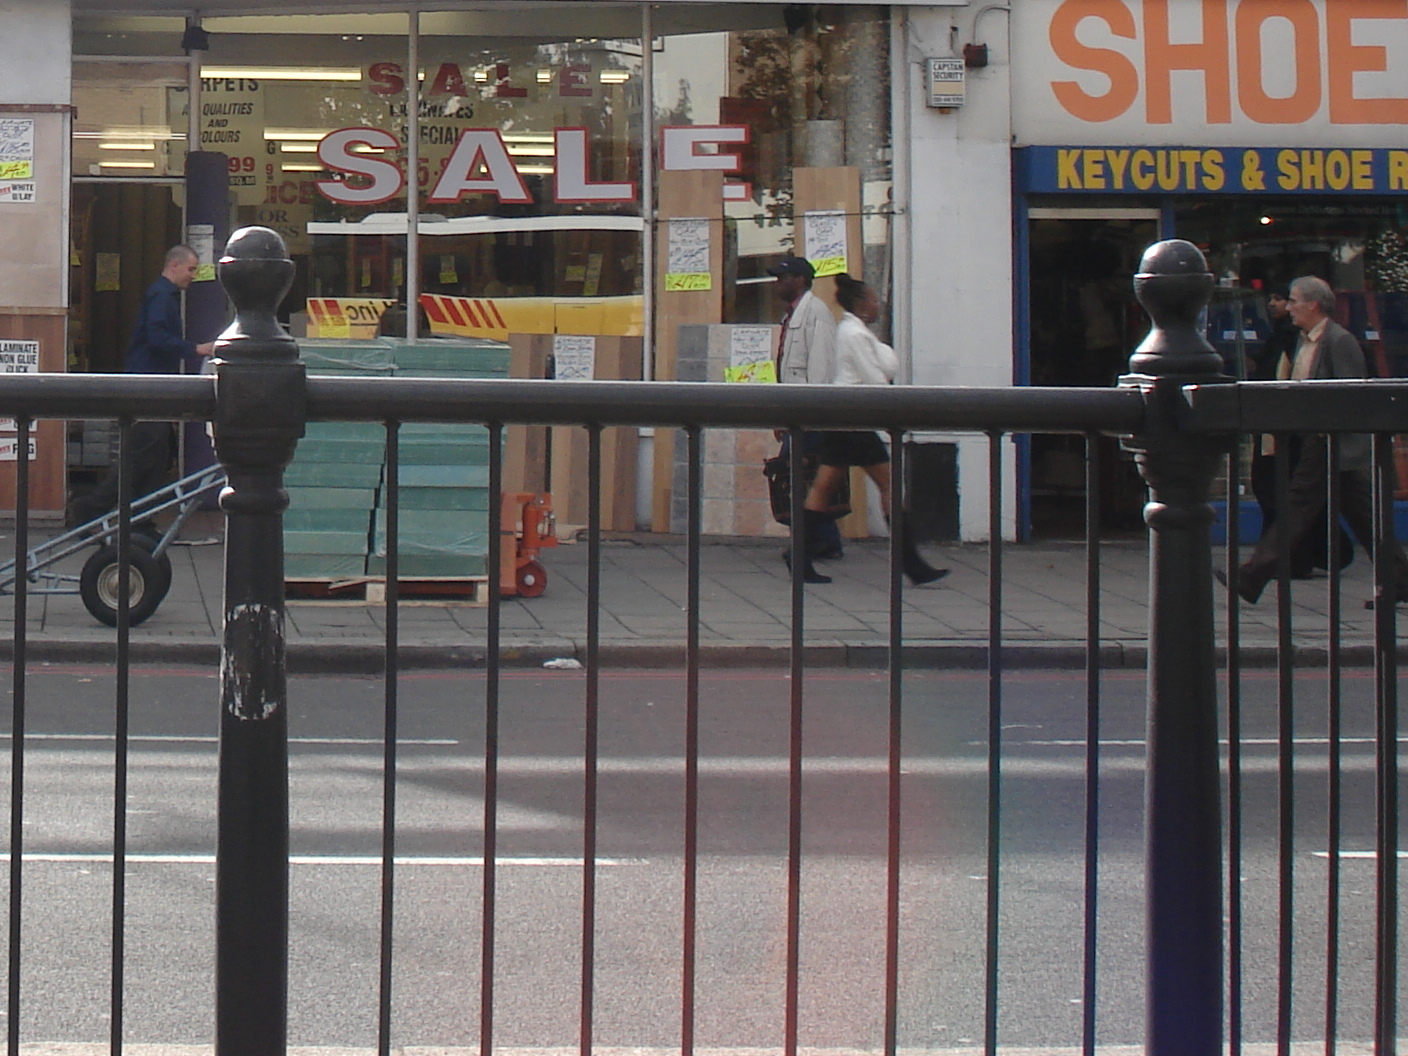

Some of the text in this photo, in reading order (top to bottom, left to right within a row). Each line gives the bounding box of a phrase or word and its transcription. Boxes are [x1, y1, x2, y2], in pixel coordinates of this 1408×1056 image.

[933, 63, 963, 71] CAPSTAN
[369, 62, 593, 98] SALE
[933, 72, 963, 80] SECURITY
[203, 103, 254, 116] QUALITIES
[208, 119, 229, 128] AND
[201, 130, 241, 143] OLOURS
[317, 124, 752, 204] SALE
[1057, 148, 1226, 191] KEYCUTS
[1241, 148, 1267, 191] &
[1277, 148, 1374, 191] SHOE
[0, 354, 37, 364] NON GLUE
